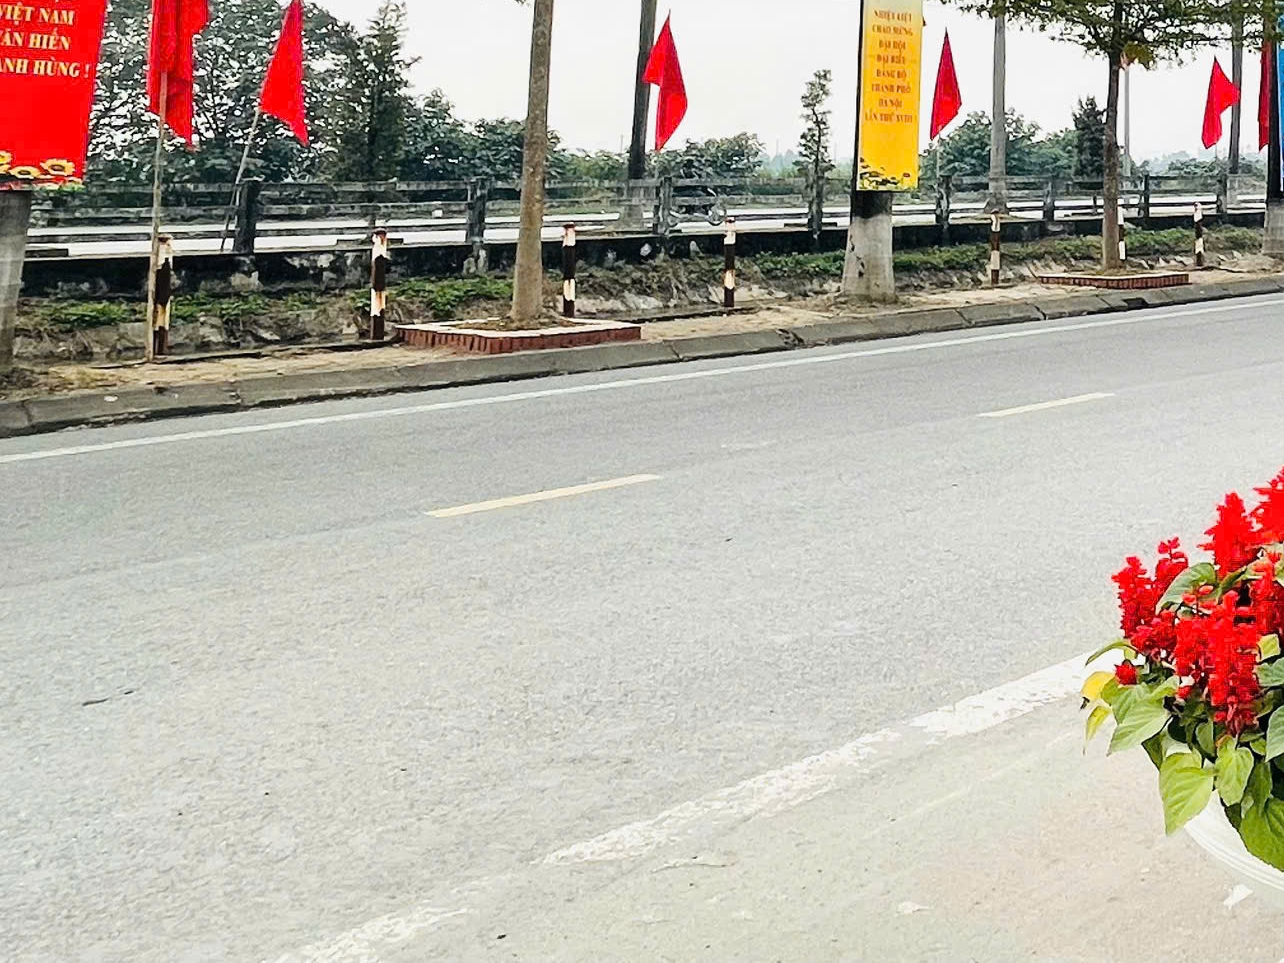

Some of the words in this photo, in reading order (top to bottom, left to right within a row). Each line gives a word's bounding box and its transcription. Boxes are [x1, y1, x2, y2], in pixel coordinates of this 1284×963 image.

[38, 7, 75, 25] NAM
[28, 27, 71, 51] HIẾN
[33, 56, 80, 78] HÙNG
